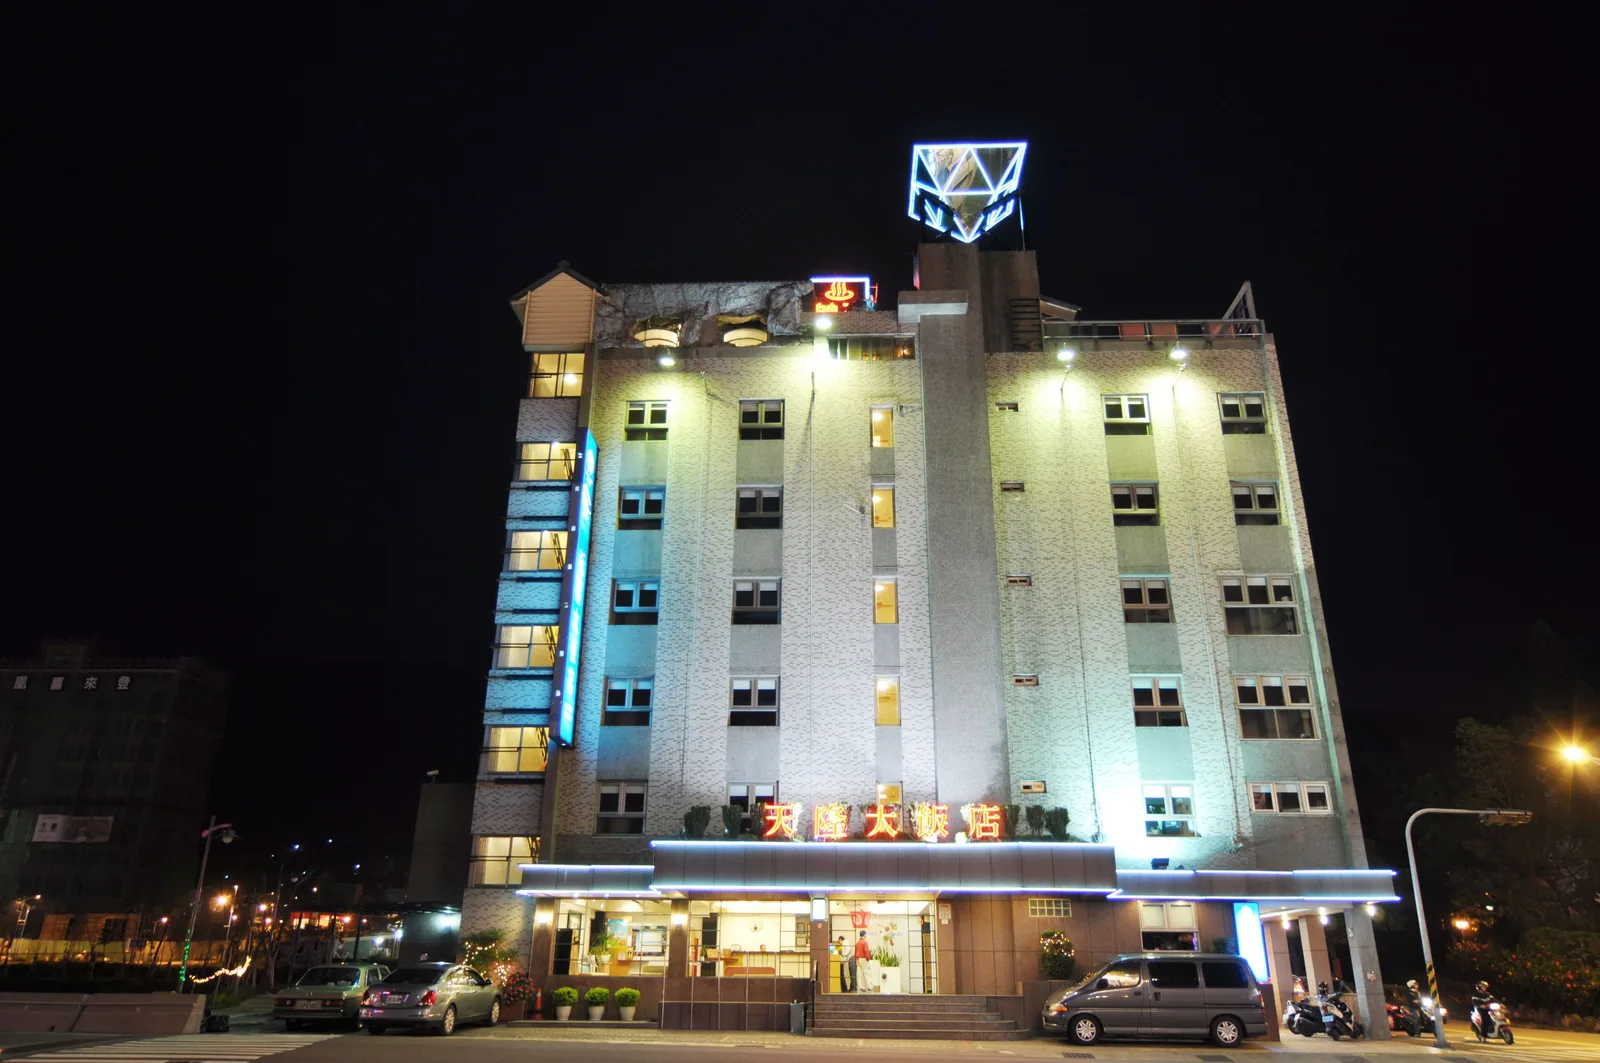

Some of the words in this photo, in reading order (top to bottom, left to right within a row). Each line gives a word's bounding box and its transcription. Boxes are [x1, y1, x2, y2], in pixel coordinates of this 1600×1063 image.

[763, 804, 1002, 838] 天隆大飯店
